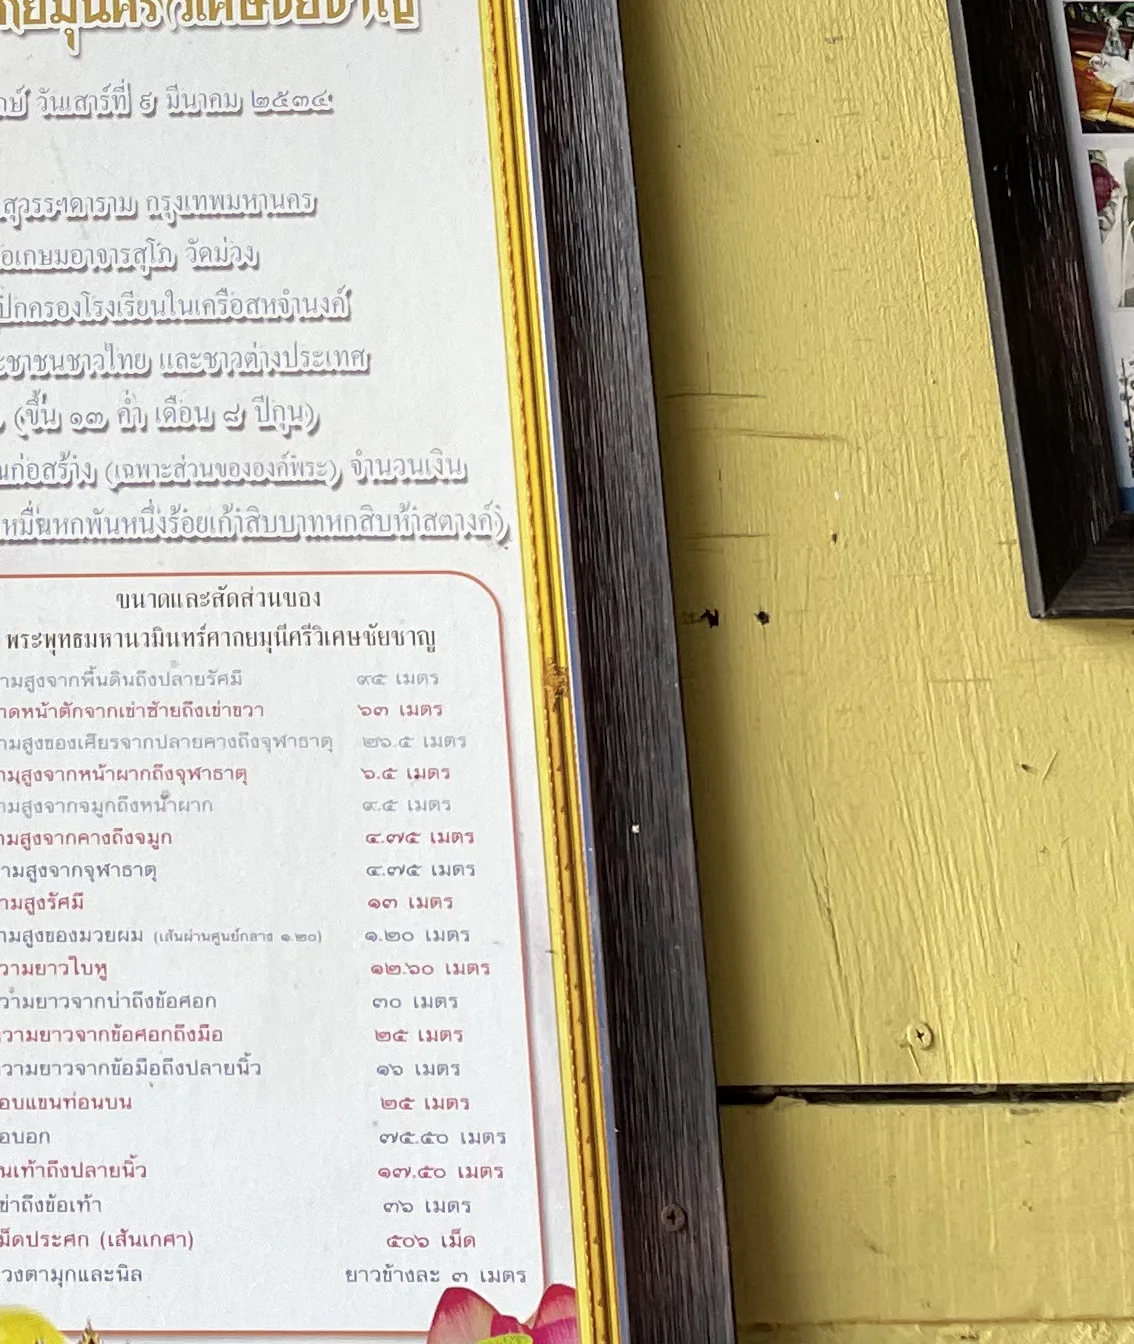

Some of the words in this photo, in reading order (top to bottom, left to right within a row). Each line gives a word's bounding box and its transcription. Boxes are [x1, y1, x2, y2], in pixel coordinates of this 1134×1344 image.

[37, 79, 131, 116] วันเสาร์ที่
[138, 94, 158, 115] ๙
[165, 84, 243, 114] มีนาคม
[250, 87, 334, 114] ๒๕๓๔
[146, 186, 318, 224] กรุงเทพมหานคร
[185, 236, 260, 270] วัดม่วง
[159, 340, 371, 377] และชาวต่างประเทศ
[13, 388, 62, 440] (ขึ้น
[69, 408, 110, 431] ๑๓
[117, 390, 148, 431] ค่ำ
[155, 394, 217, 431] เดือน
[221, 404, 247, 429] ๘
[253, 396, 320, 436] ปีกุน)
[351, 447, 468, 485] จำนวนเงิน
[116, 584, 322, 610] ขนาดและสัดส่วนของ
[6, 623, 436, 656] พระพุทธมหานวมินทร์ศากยมุนีศรีวิเศษชัยชาญ
[356, 672, 387, 686] ๙๕
[396, 671, 439, 686] เมตร
[358, 703, 389, 717] ๖๓
[399, 703, 443, 717] เมตร
[424, 734, 467, 749] เมตร
[361, 767, 398, 781] ๖.๕
[407, 767, 451, 780] เมตร
[362, 798, 398, 812] ๙.๕
[408, 798, 451, 812] เมตร
[365, 830, 421, 844] ๔.๗๕
[430, 830, 475, 844] เมตร
[366, 863, 421, 877] ๔.๗๕
[431, 863, 476, 877] เมตร
[368, 896, 398, 910] ๑๓
[409, 895, 453, 909] เมตร
[365, 929, 414, 943] ๑.๒๐
[425, 928, 470, 942] เมตร
[370, 963, 434, 976] ๑๒.๖๐
[445, 962, 490, 975] เมตร
[372, 996, 402, 1009] ๓๐
[413, 996, 458, 1009] เมตร
[375, 1029, 409, 1042] ๒๕
[418, 1029, 463, 1042] เมตร
[376, 1063, 403, 1076] ๑๖
[415, 1063, 460, 1076] เมตร
[380, 1097, 415, 1110] ๒๕
[424, 1097, 470, 1110] เมตร
[379, 1131, 449, 1145] ๗๕.๕๐
[460, 1131, 506, 1145] เมตร
[378, 1165, 446, 1179] ๑๗.๕๐
[458, 1166, 504, 1179] เมตร
[383, 1200, 414, 1213] ๓๖
[425, 1200, 471, 1213] เมตร
[100, 1228, 194, 1250] (เส้นเกศา)
[386, 1234, 430, 1248] ๕๐๖
[441, 1228, 476, 1248] เม็ด
[346, 1263, 440, 1283] ยาวข้างละ
[451, 1270, 468, 1283] ๓
[480, 1269, 527, 1283] เมตร
